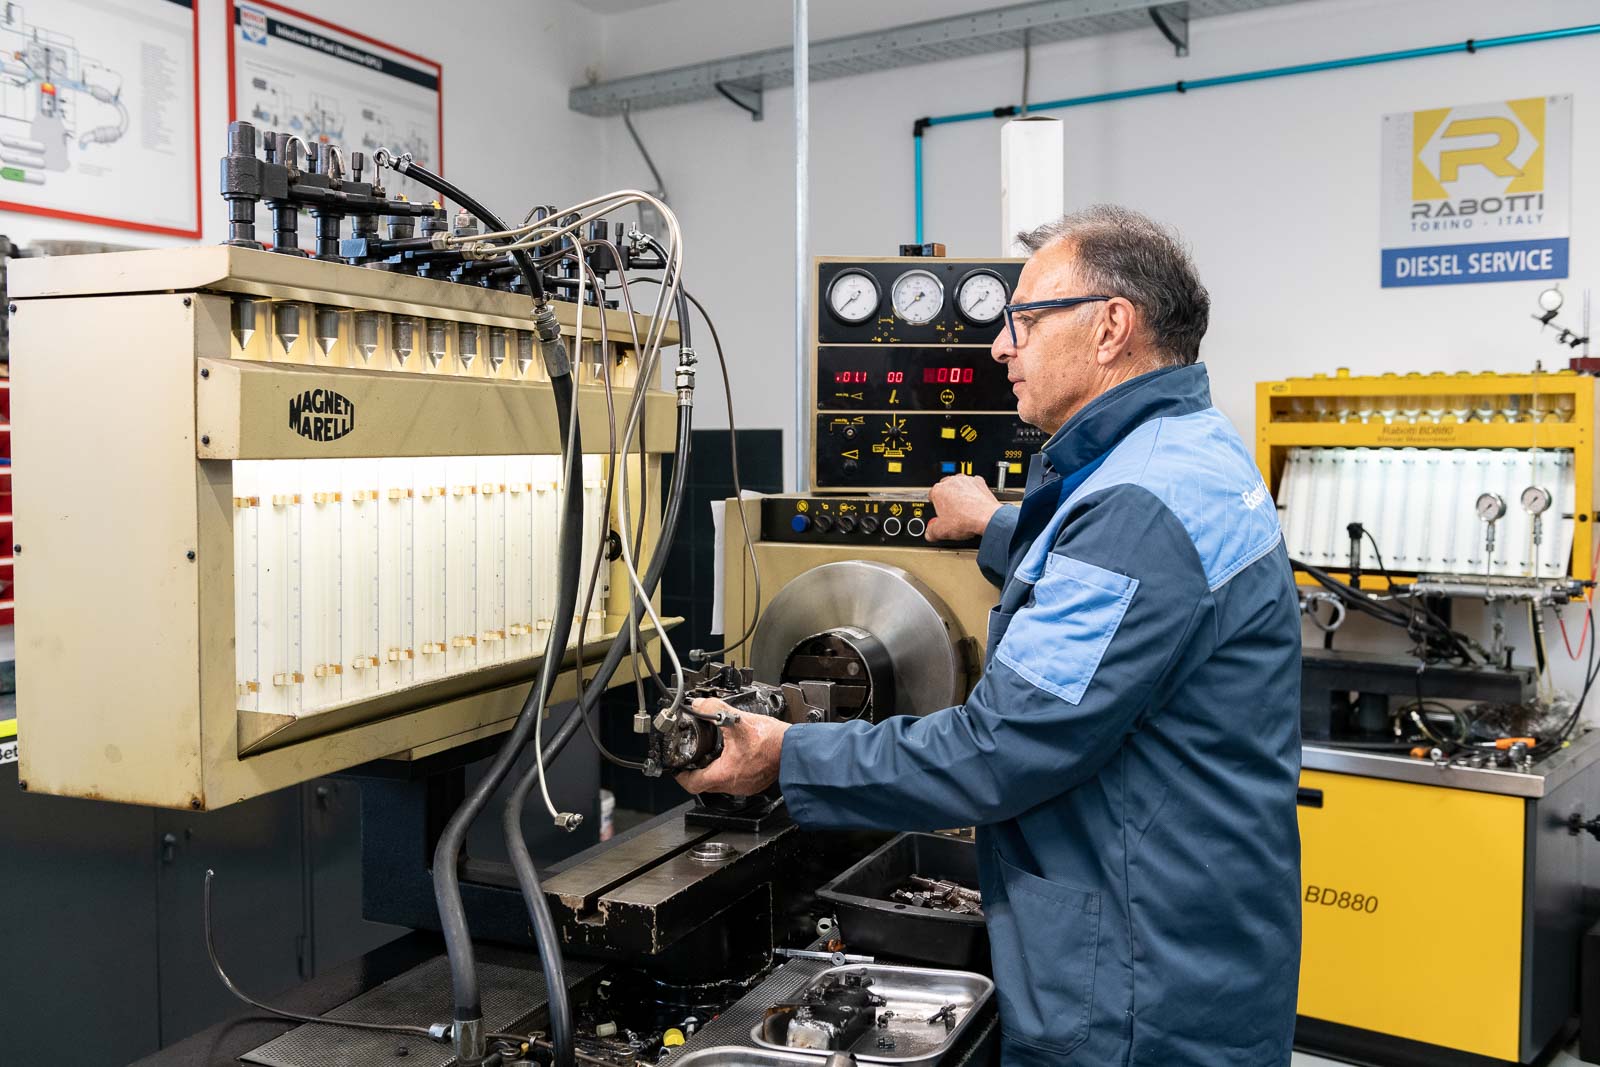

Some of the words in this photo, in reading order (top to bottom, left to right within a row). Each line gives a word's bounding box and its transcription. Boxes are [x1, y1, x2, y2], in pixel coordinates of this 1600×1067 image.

[1411, 193, 1544, 220] RABOTTI
[1411, 218, 1473, 232] TORINO
[1498, 214, 1544, 226] ITALY
[1396, 254, 1463, 278] DIESEL
[1468, 249, 1553, 274] SERVICE
[289, 389, 354, 418] MAGNETI
[289, 415, 354, 441] MARELLI
[1004, 450, 1022, 459] 9999
[0, 745, 18, 761] et
[1304, 885, 1379, 914] BD880
